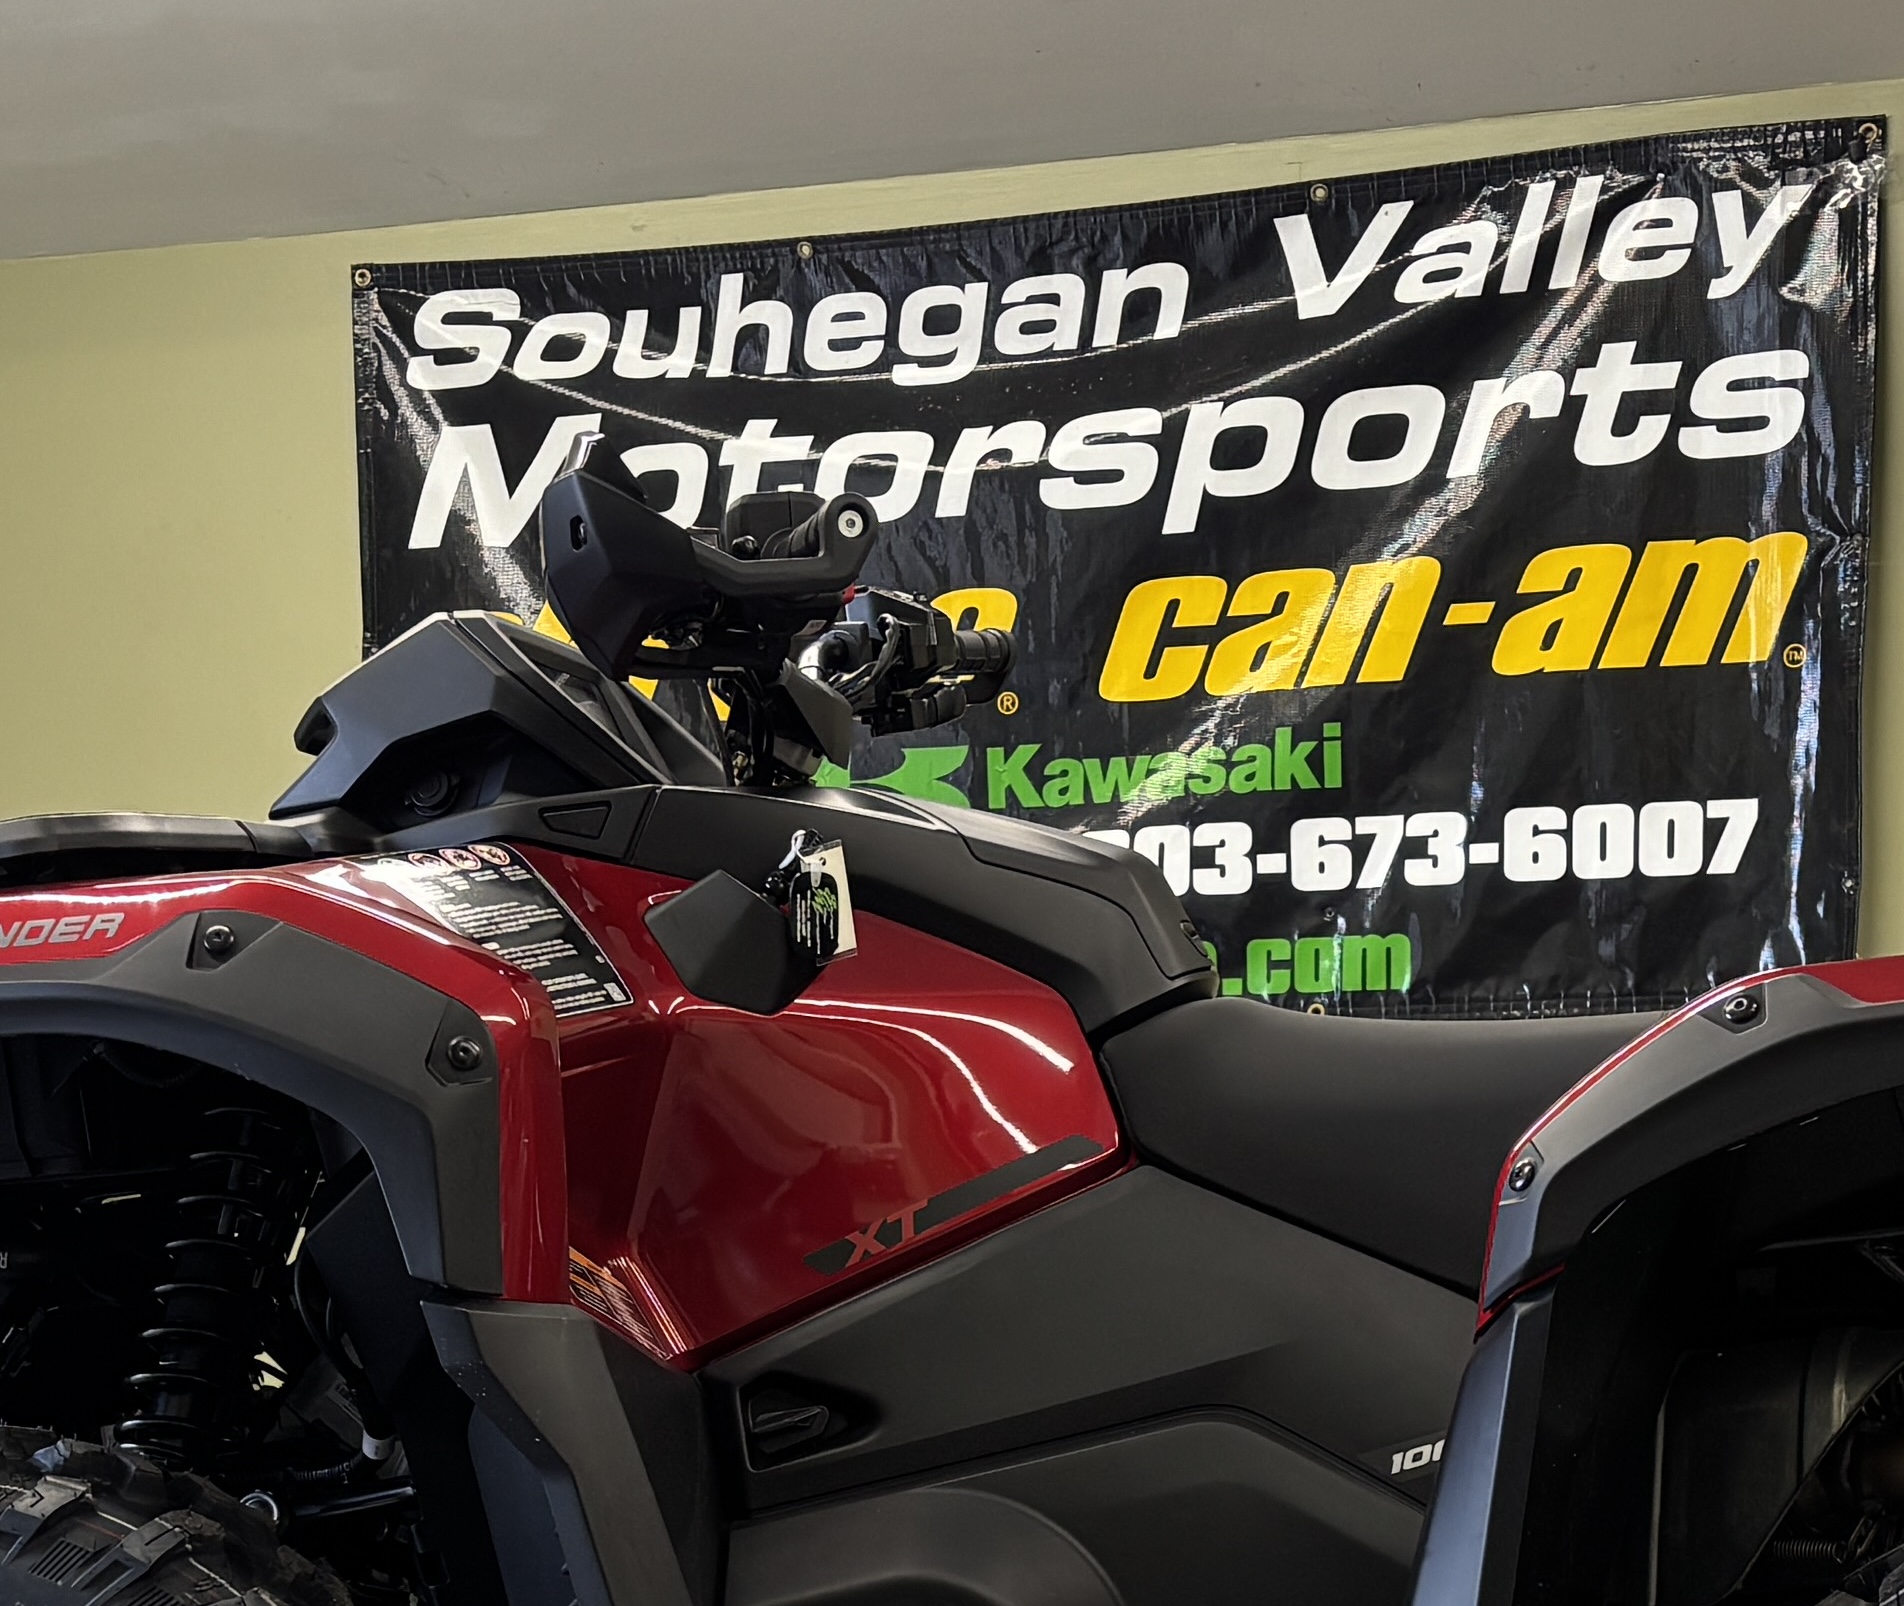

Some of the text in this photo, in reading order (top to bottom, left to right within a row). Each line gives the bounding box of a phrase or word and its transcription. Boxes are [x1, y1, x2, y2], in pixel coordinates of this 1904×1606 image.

[407, 172, 1813, 390] Souhegan Valley
[1097, 531, 1808, 702] can-am
[986, 722, 1342, 809] Kawasaki
[1082, 799, 1760, 897] 03-673-6007
[843, 1197, 930, 1269] XT
